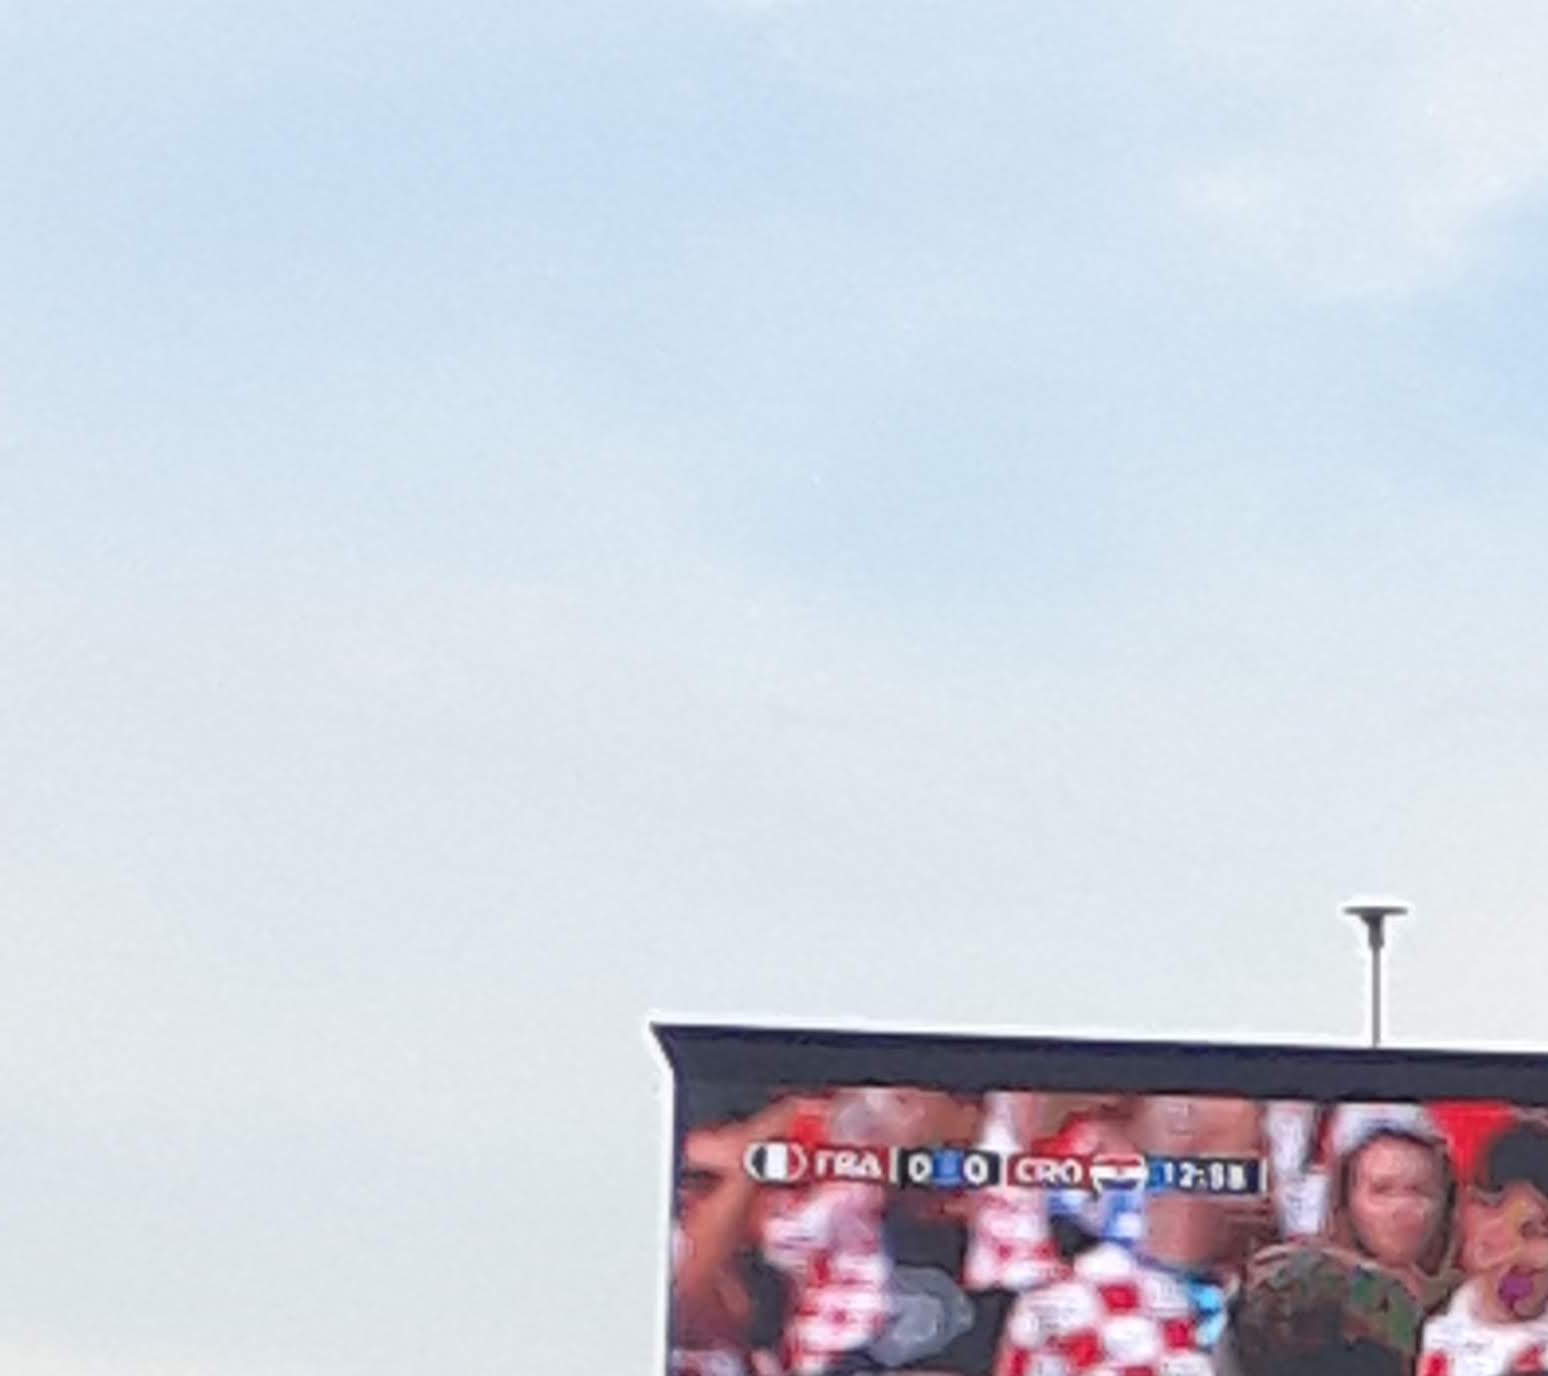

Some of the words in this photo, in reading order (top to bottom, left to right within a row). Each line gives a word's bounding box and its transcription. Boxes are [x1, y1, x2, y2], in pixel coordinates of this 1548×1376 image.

[814, 1150, 882, 1178] FRA
[908, 1153, 930, 1183] 0
[964, 1154, 988, 1185] 0
[1016, 1158, 1083, 1184] CRO
